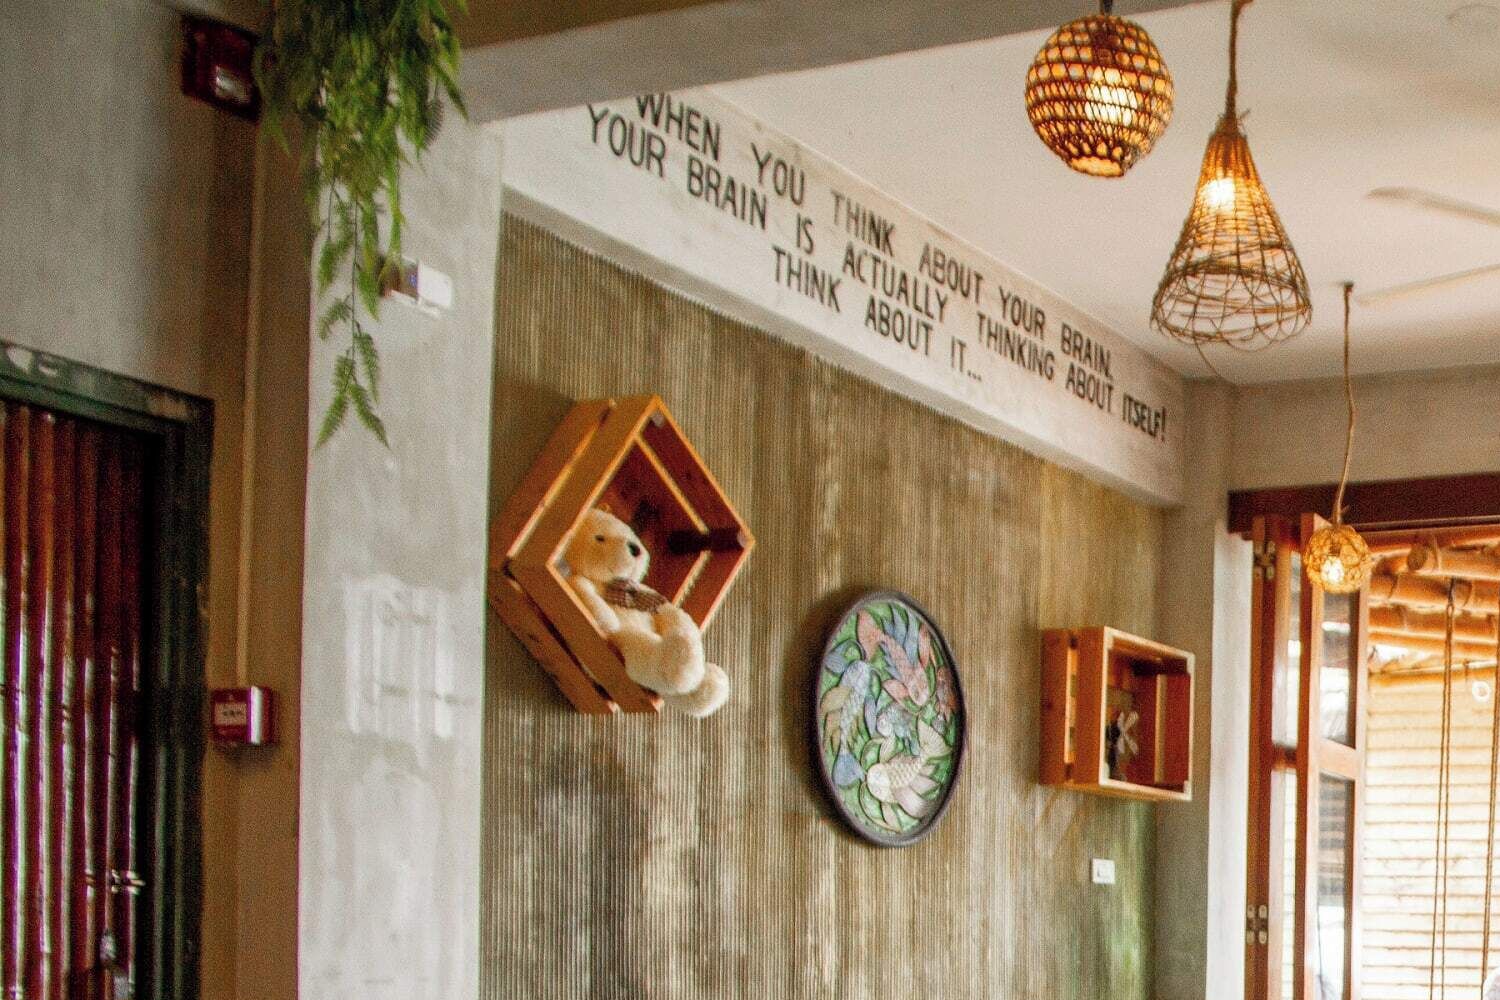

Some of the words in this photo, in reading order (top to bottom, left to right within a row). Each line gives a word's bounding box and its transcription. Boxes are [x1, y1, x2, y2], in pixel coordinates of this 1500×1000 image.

[587, 103, 666, 178] YOUR
[686, 154, 768, 231] BRAIN
[796, 212, 814, 255] IS
[842, 240, 949, 323] ACTUALLY
[976, 312, 1055, 381] THINKING
[1065, 362, 1114, 413] ABOUT
[1122, 392, 1166, 442] ITSELF!
[636, 91, 721, 162] WHEN
[750, 142, 805, 206] YOU
[831, 189, 895, 257] THINK
[918, 242, 983, 304] ABOUT
[998, 285, 1046, 340] YOUR
[772, 243, 842, 312] THINK
[864, 294, 934, 356] ABOUT
